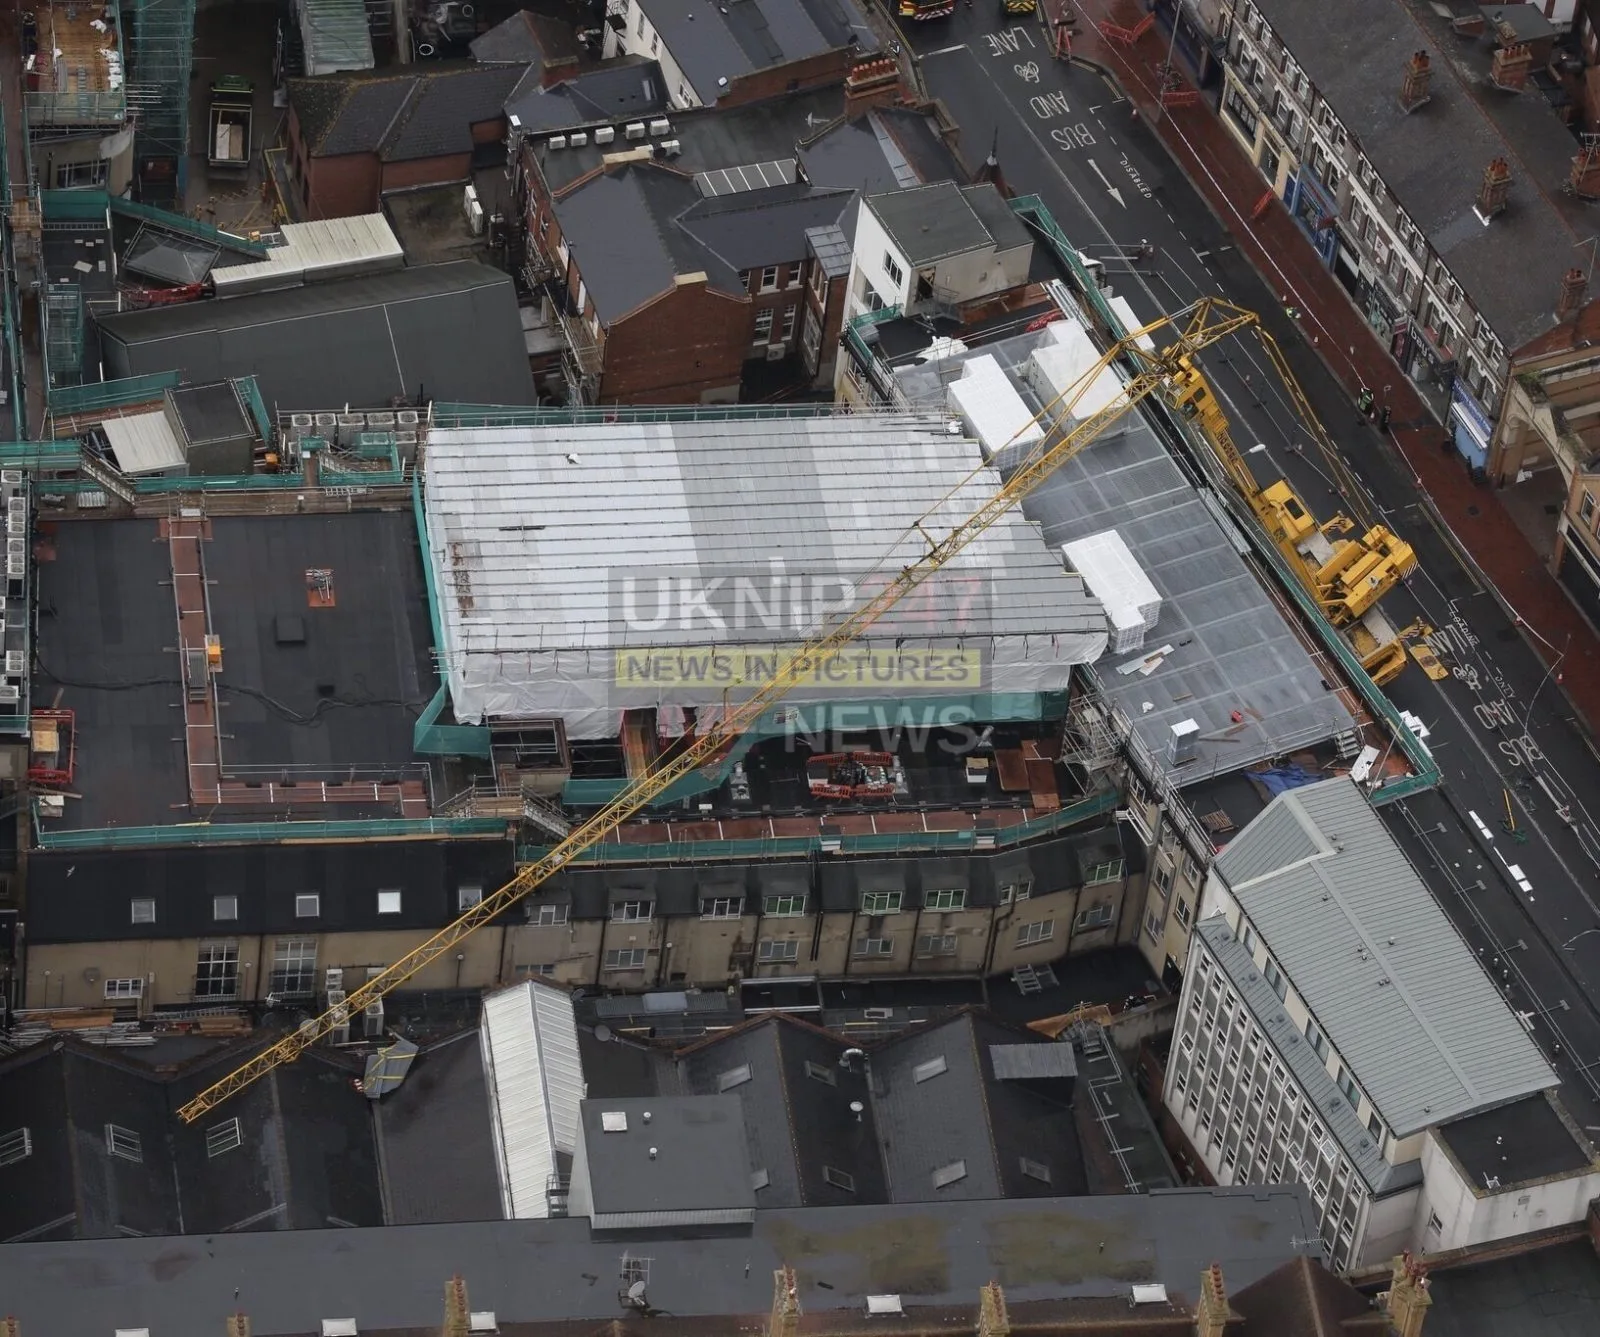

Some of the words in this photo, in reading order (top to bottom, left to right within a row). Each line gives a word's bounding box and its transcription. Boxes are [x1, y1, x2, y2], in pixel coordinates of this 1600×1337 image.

[981, 27, 1036, 57] LANE
[1029, 90, 1071, 119] AND
[1050, 122, 1097, 151] BUS
[1119, 159, 1153, 199] DISABLED
[1448, 609, 1479, 647] LOADING
[1494, 675, 1517, 698] ONLY
[1473, 698, 1515, 730] AND
[1498, 735, 1544, 767] BUS
